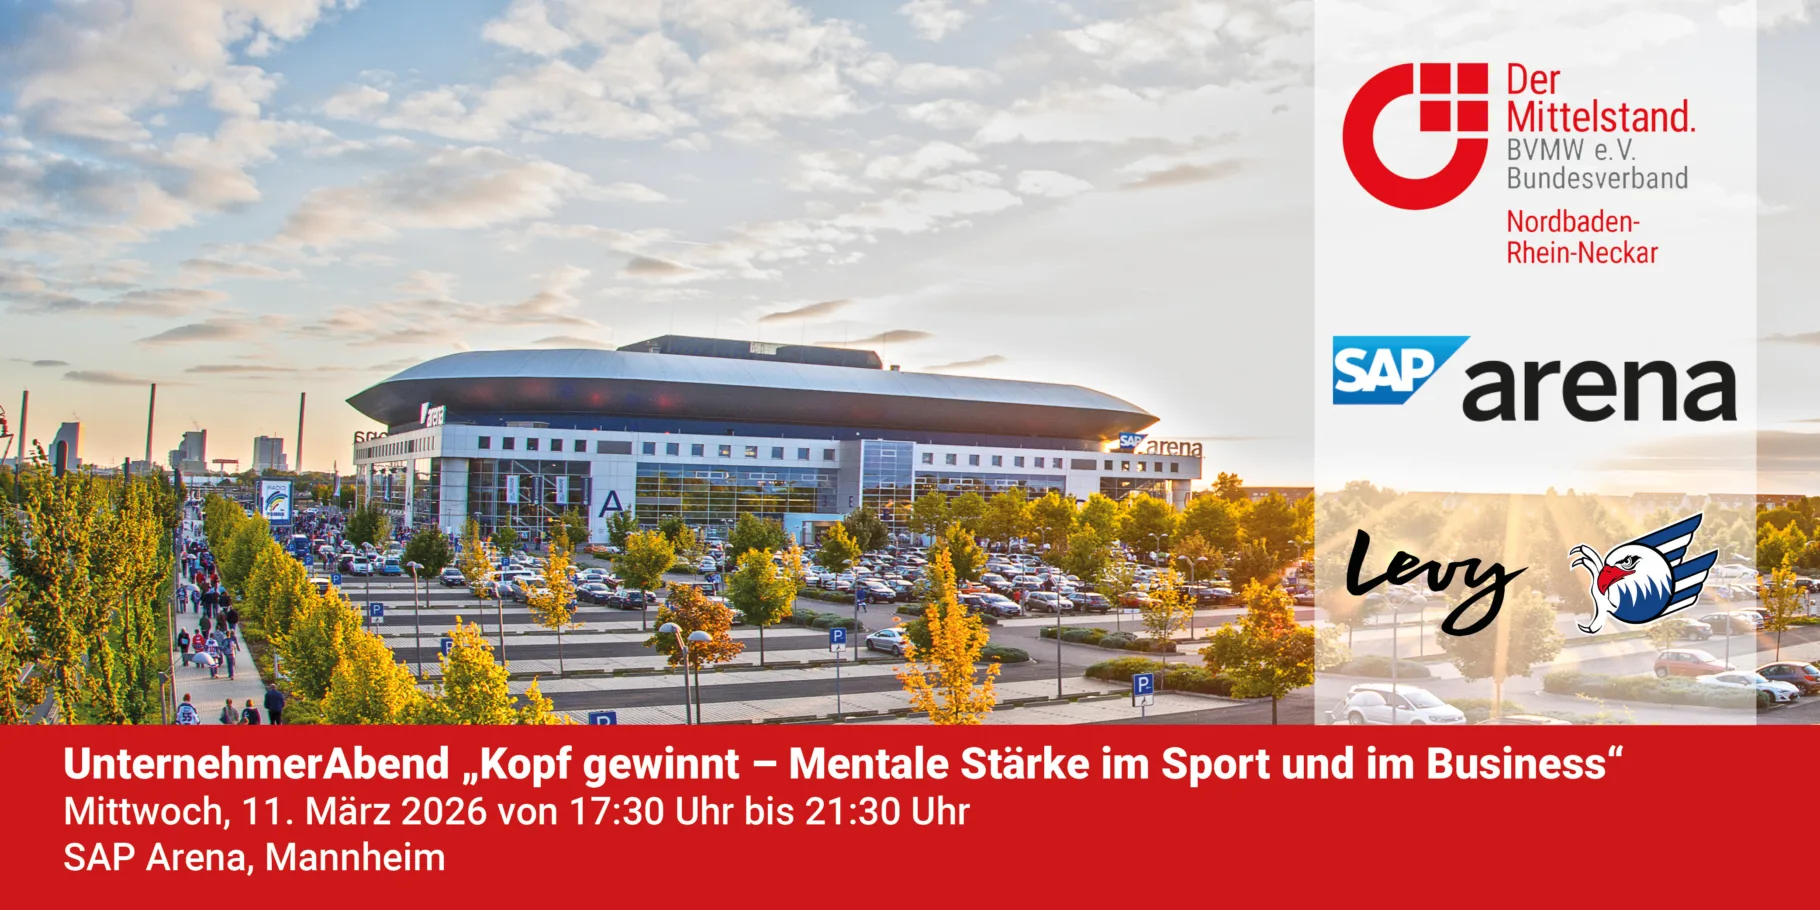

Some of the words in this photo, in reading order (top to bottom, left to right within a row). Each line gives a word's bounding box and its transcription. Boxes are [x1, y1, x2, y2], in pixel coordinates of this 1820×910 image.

[1120, 434, 1142, 447] SAP
[1146, 440, 1203, 458] arena
[598, 490, 625, 518] A
[333, 575, 339, 583] P
[374, 605, 381, 614] P
[833, 629, 843, 642] P
[1138, 676, 1149, 693] P
[182, 712, 193, 722] 55
